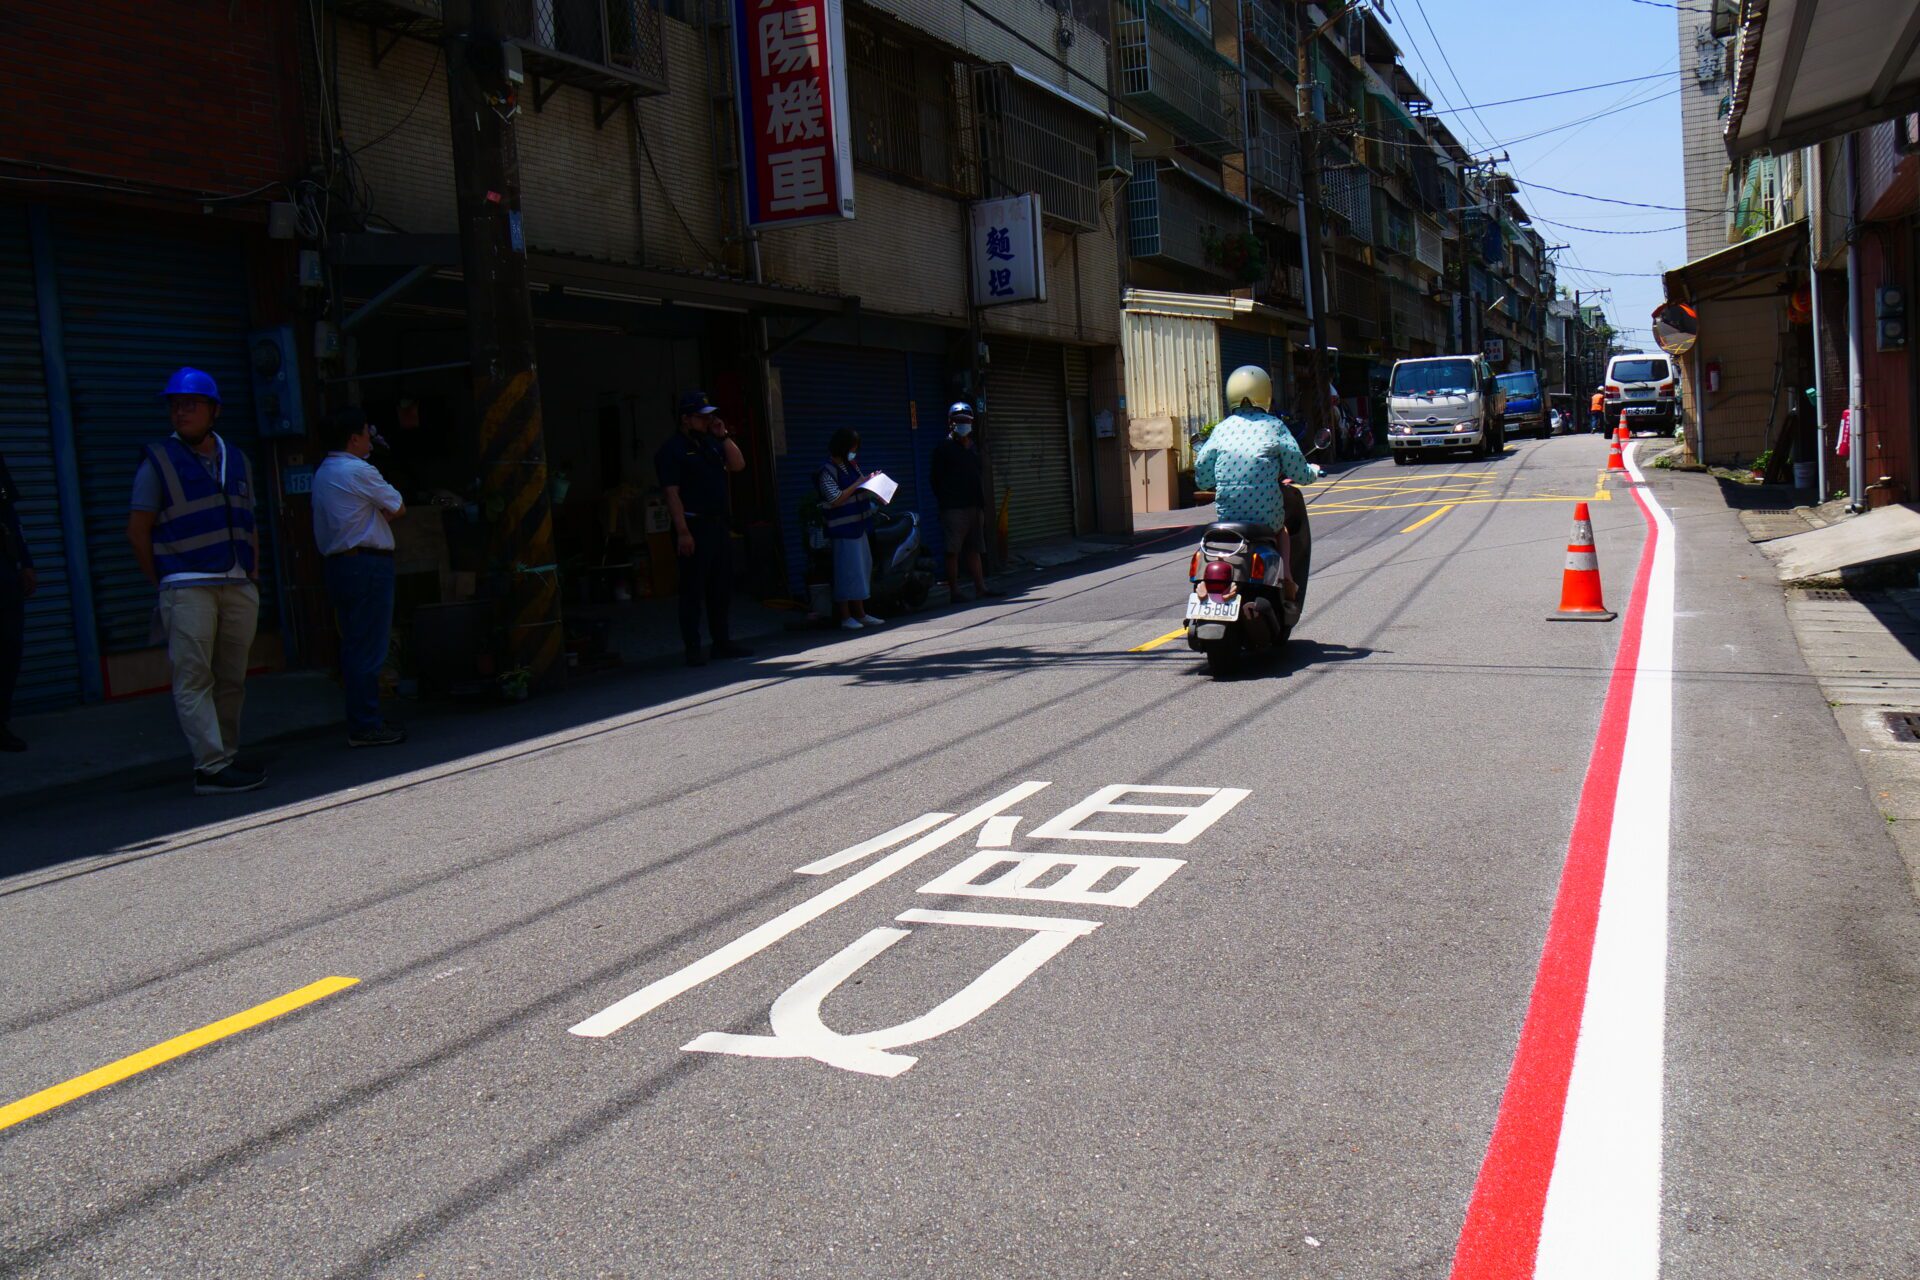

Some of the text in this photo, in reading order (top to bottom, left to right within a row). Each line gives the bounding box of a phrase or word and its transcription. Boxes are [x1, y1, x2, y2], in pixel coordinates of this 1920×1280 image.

[757, 0, 829, 212] 陽機車
[569, 780, 1252, 1078] 慢
